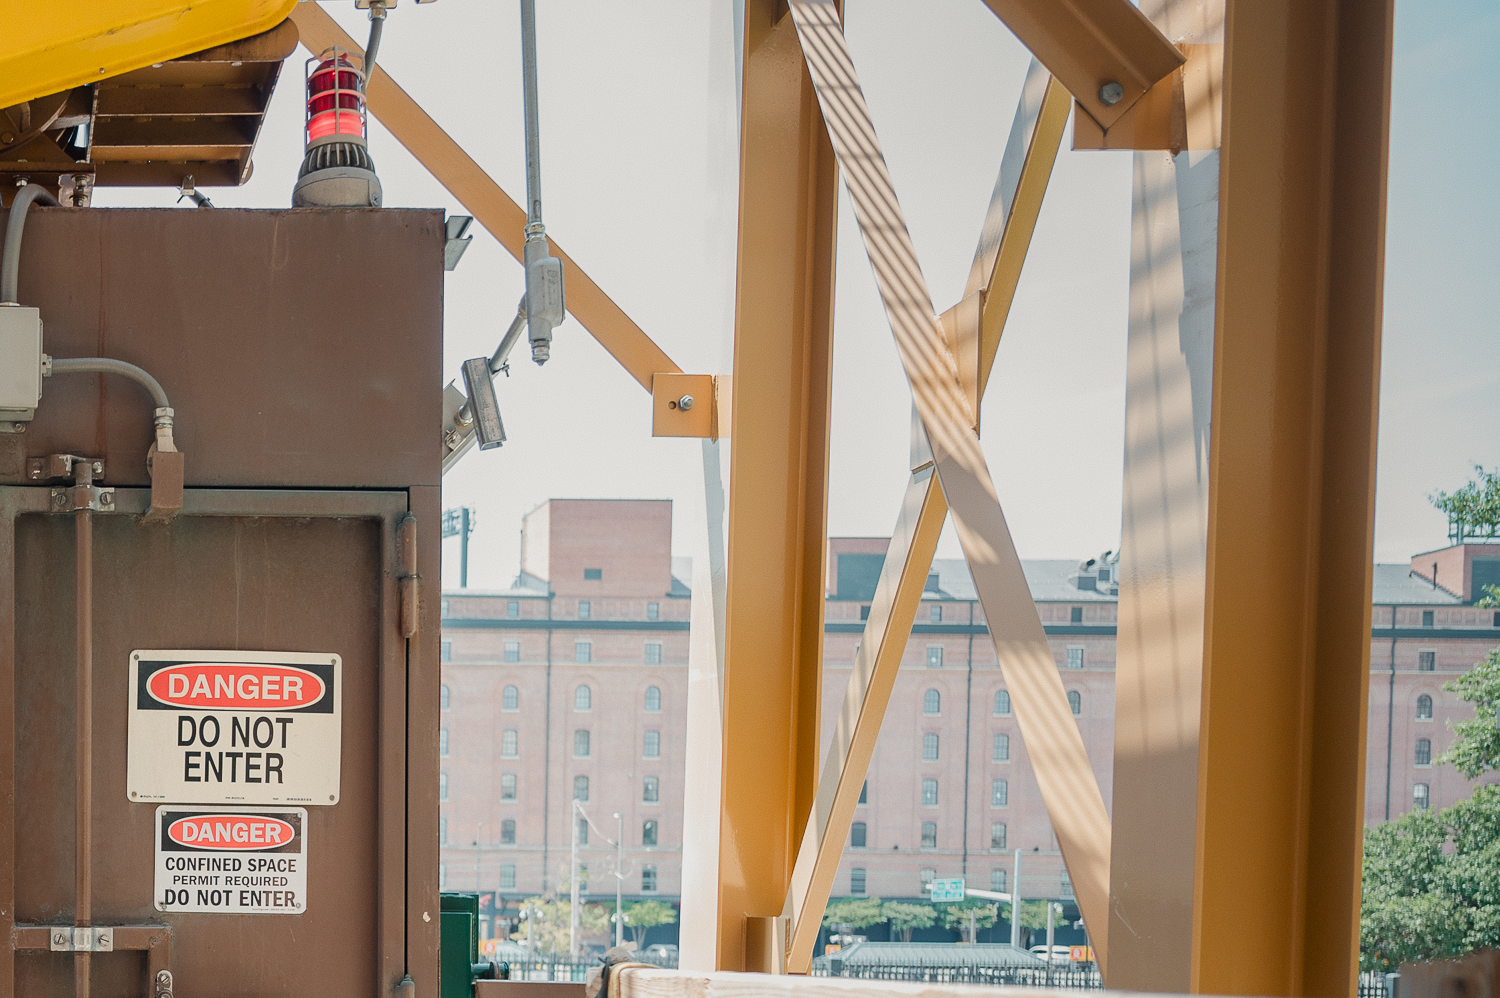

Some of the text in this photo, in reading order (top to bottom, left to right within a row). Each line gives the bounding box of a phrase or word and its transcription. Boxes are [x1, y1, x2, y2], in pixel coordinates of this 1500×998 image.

[168, 673, 303, 701] DANGER
[177, 715, 294, 749] DO NOT
[184, 751, 284, 784] ENTER
[181, 821, 282, 844] DANGER
[165, 857, 297, 873] CONFINED SPACE
[172, 875, 289, 888] PERMIT REQUIRED
[164, 888, 296, 908] DO NOT ENTER
